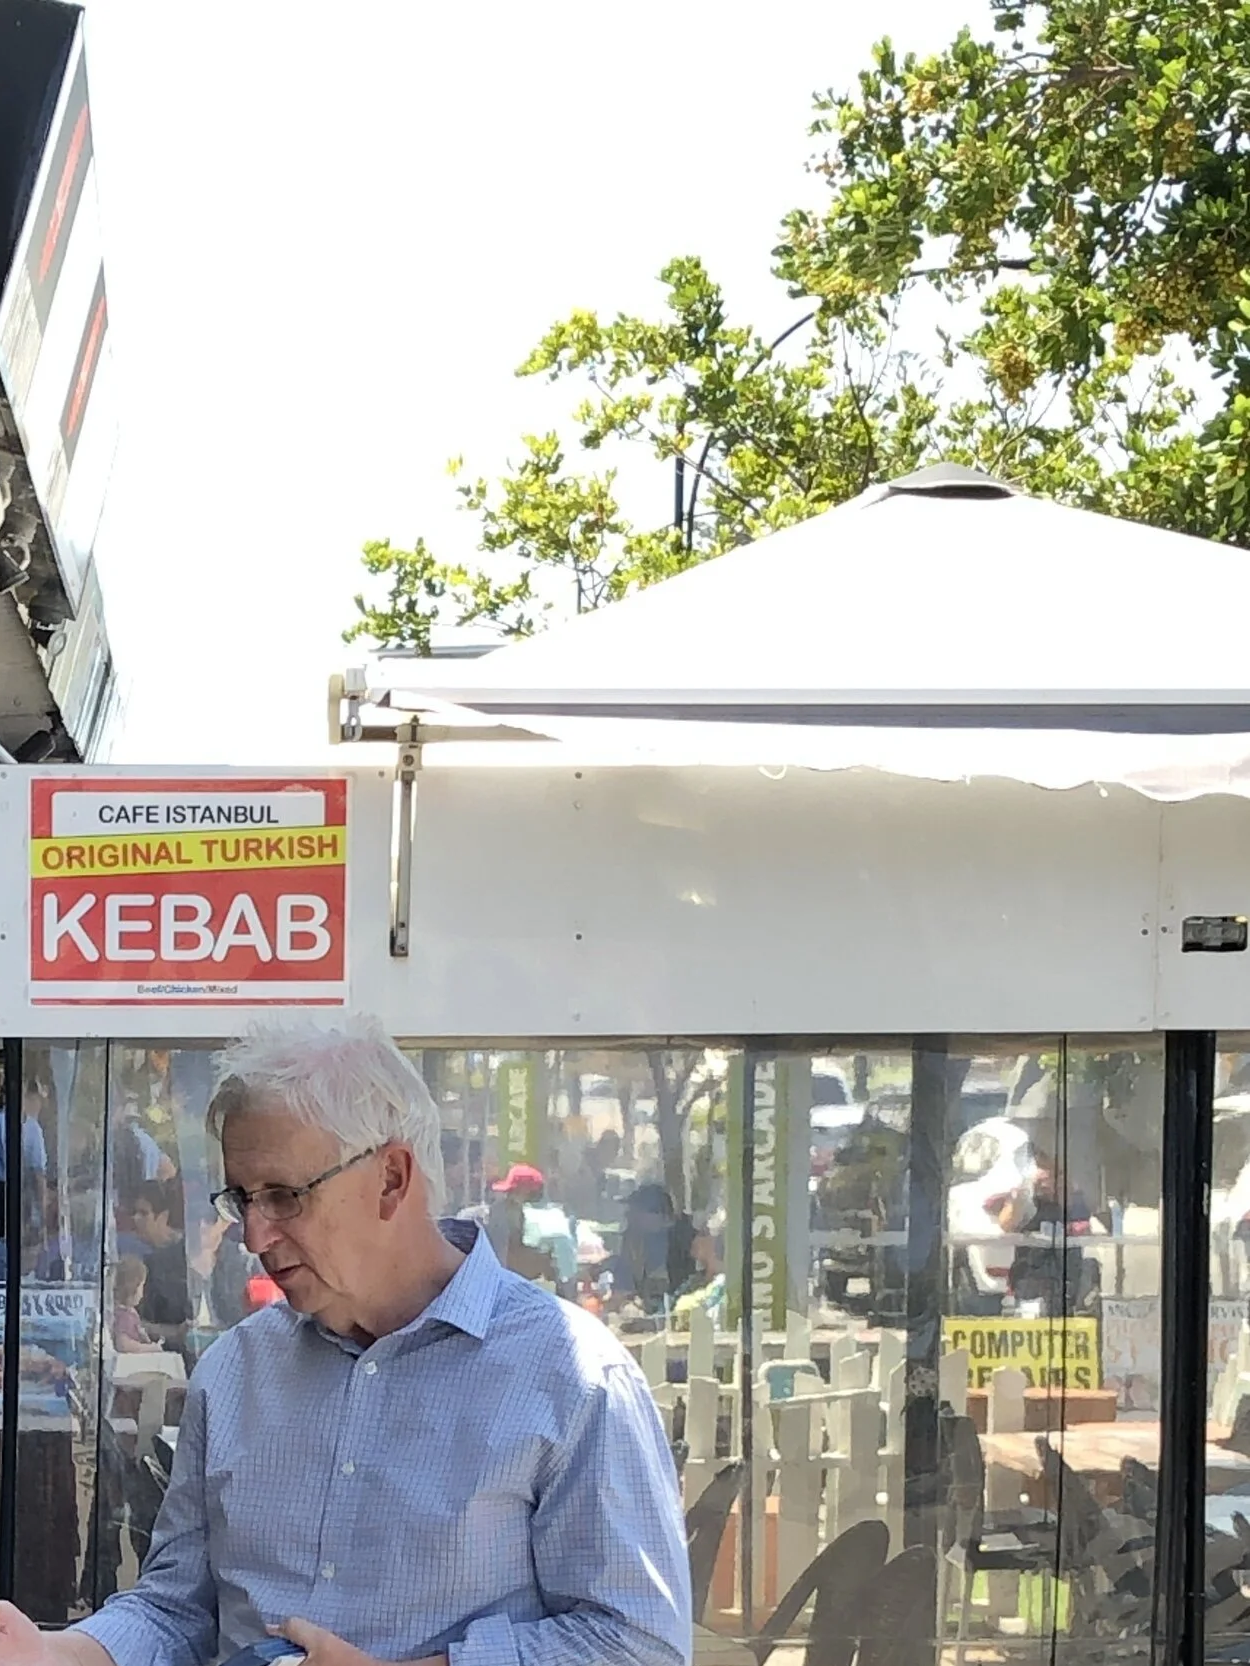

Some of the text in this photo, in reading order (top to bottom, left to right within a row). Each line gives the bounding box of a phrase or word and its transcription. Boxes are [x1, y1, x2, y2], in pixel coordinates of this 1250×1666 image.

[99, 805, 279, 824] CAFE ISTANBUL
[41, 834, 339, 871] ORIGINAL TURKISH
[42, 892, 332, 963] KEBAB
[952, 1328, 1090, 1361] COMPUTER
